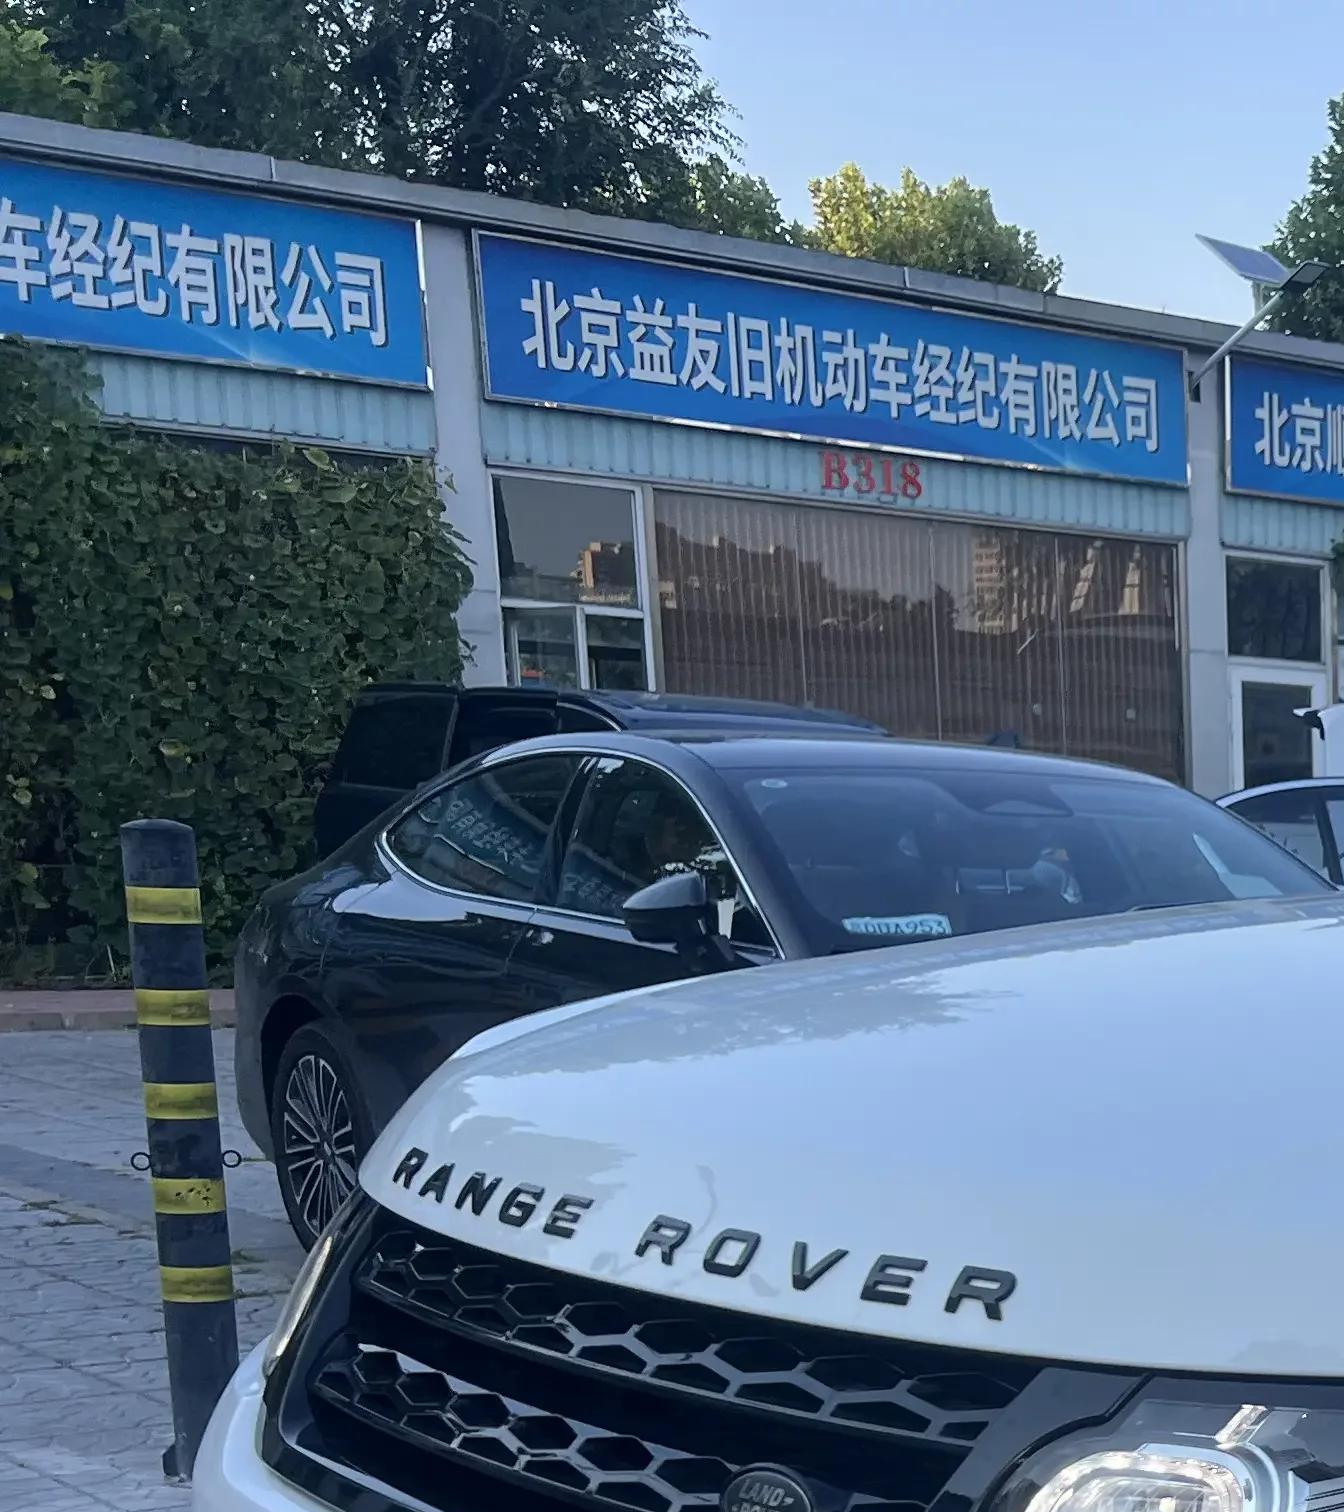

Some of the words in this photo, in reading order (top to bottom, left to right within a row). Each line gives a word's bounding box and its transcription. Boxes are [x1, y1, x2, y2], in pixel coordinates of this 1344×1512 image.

[0, 197, 387, 347] 车经纪有限公司
[520, 278, 1159, 453] 北京益友旧机动车经纪有限公司
[822, 451, 923, 500] B318
[392, 1146, 595, 1239] RANGE
[634, 1213, 1018, 1321] ROVER
[738, 1479, 786, 1507] LAND
